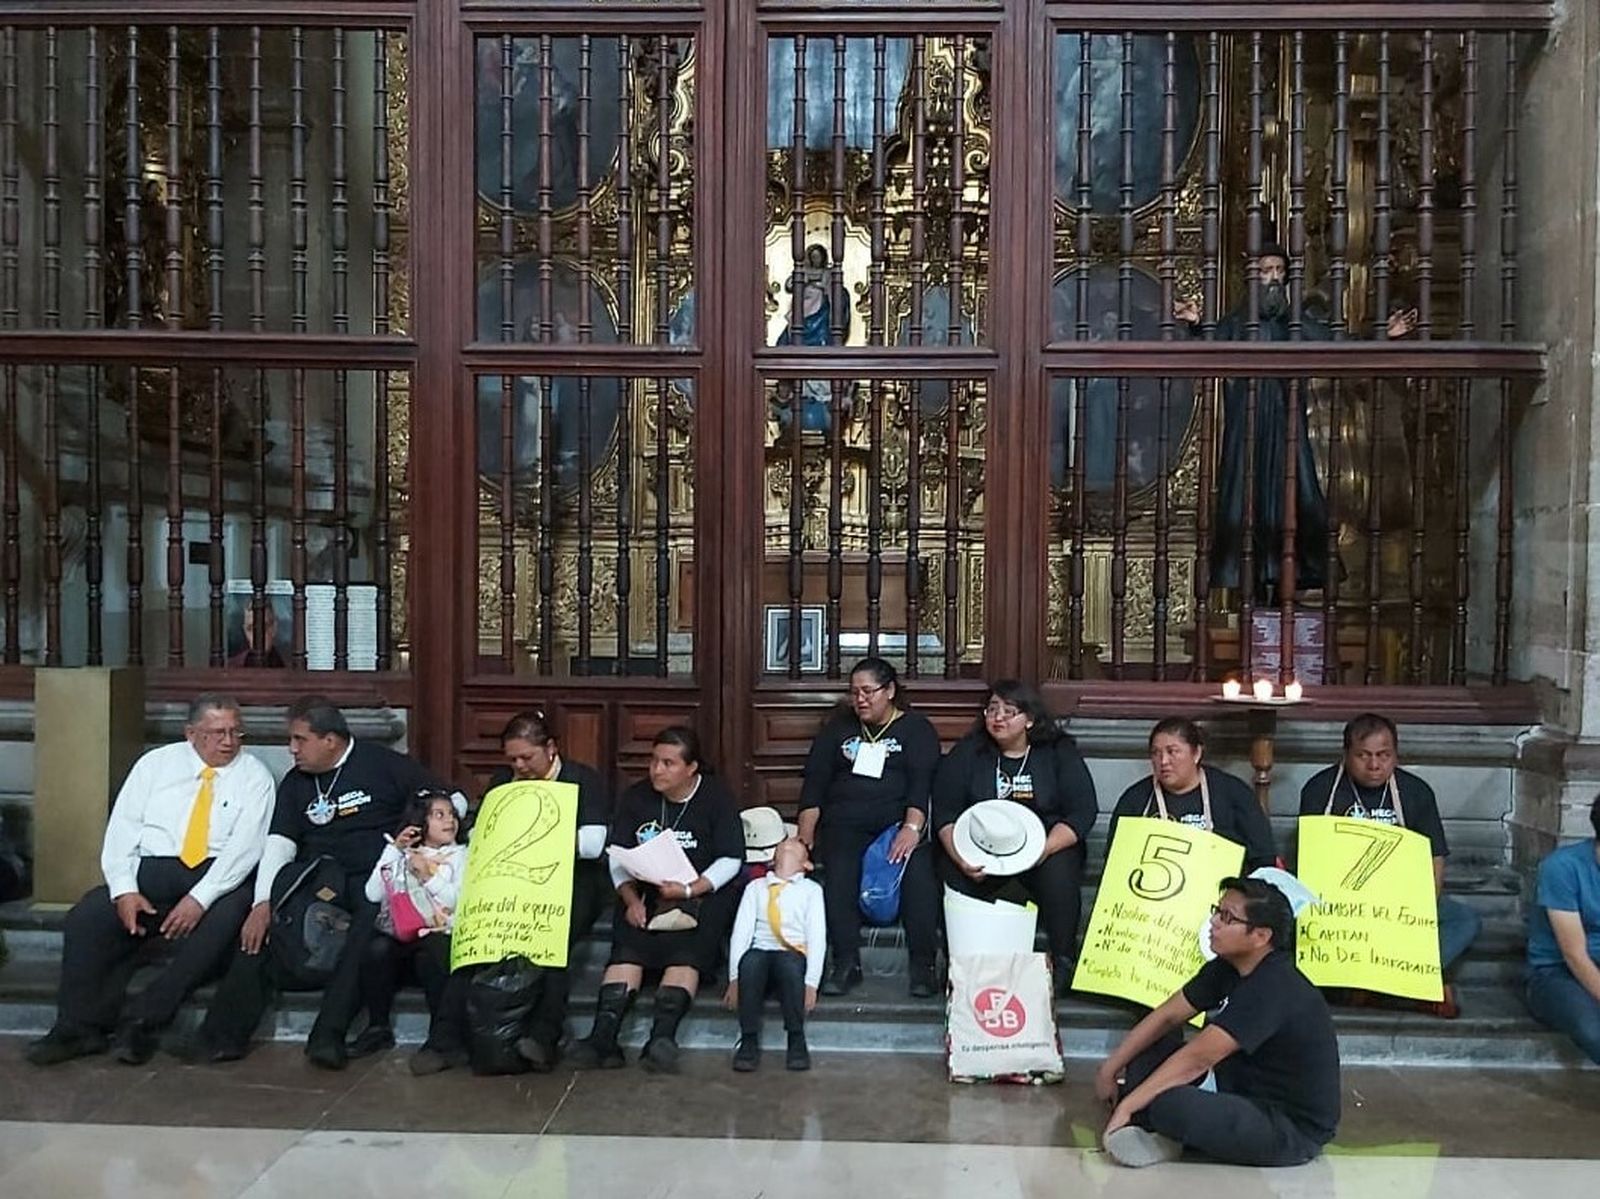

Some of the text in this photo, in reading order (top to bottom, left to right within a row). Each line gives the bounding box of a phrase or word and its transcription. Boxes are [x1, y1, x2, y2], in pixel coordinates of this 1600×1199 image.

[472, 784, 561, 886] 2
[1128, 833, 1193, 901] 5
[1334, 822, 1404, 891] 7
